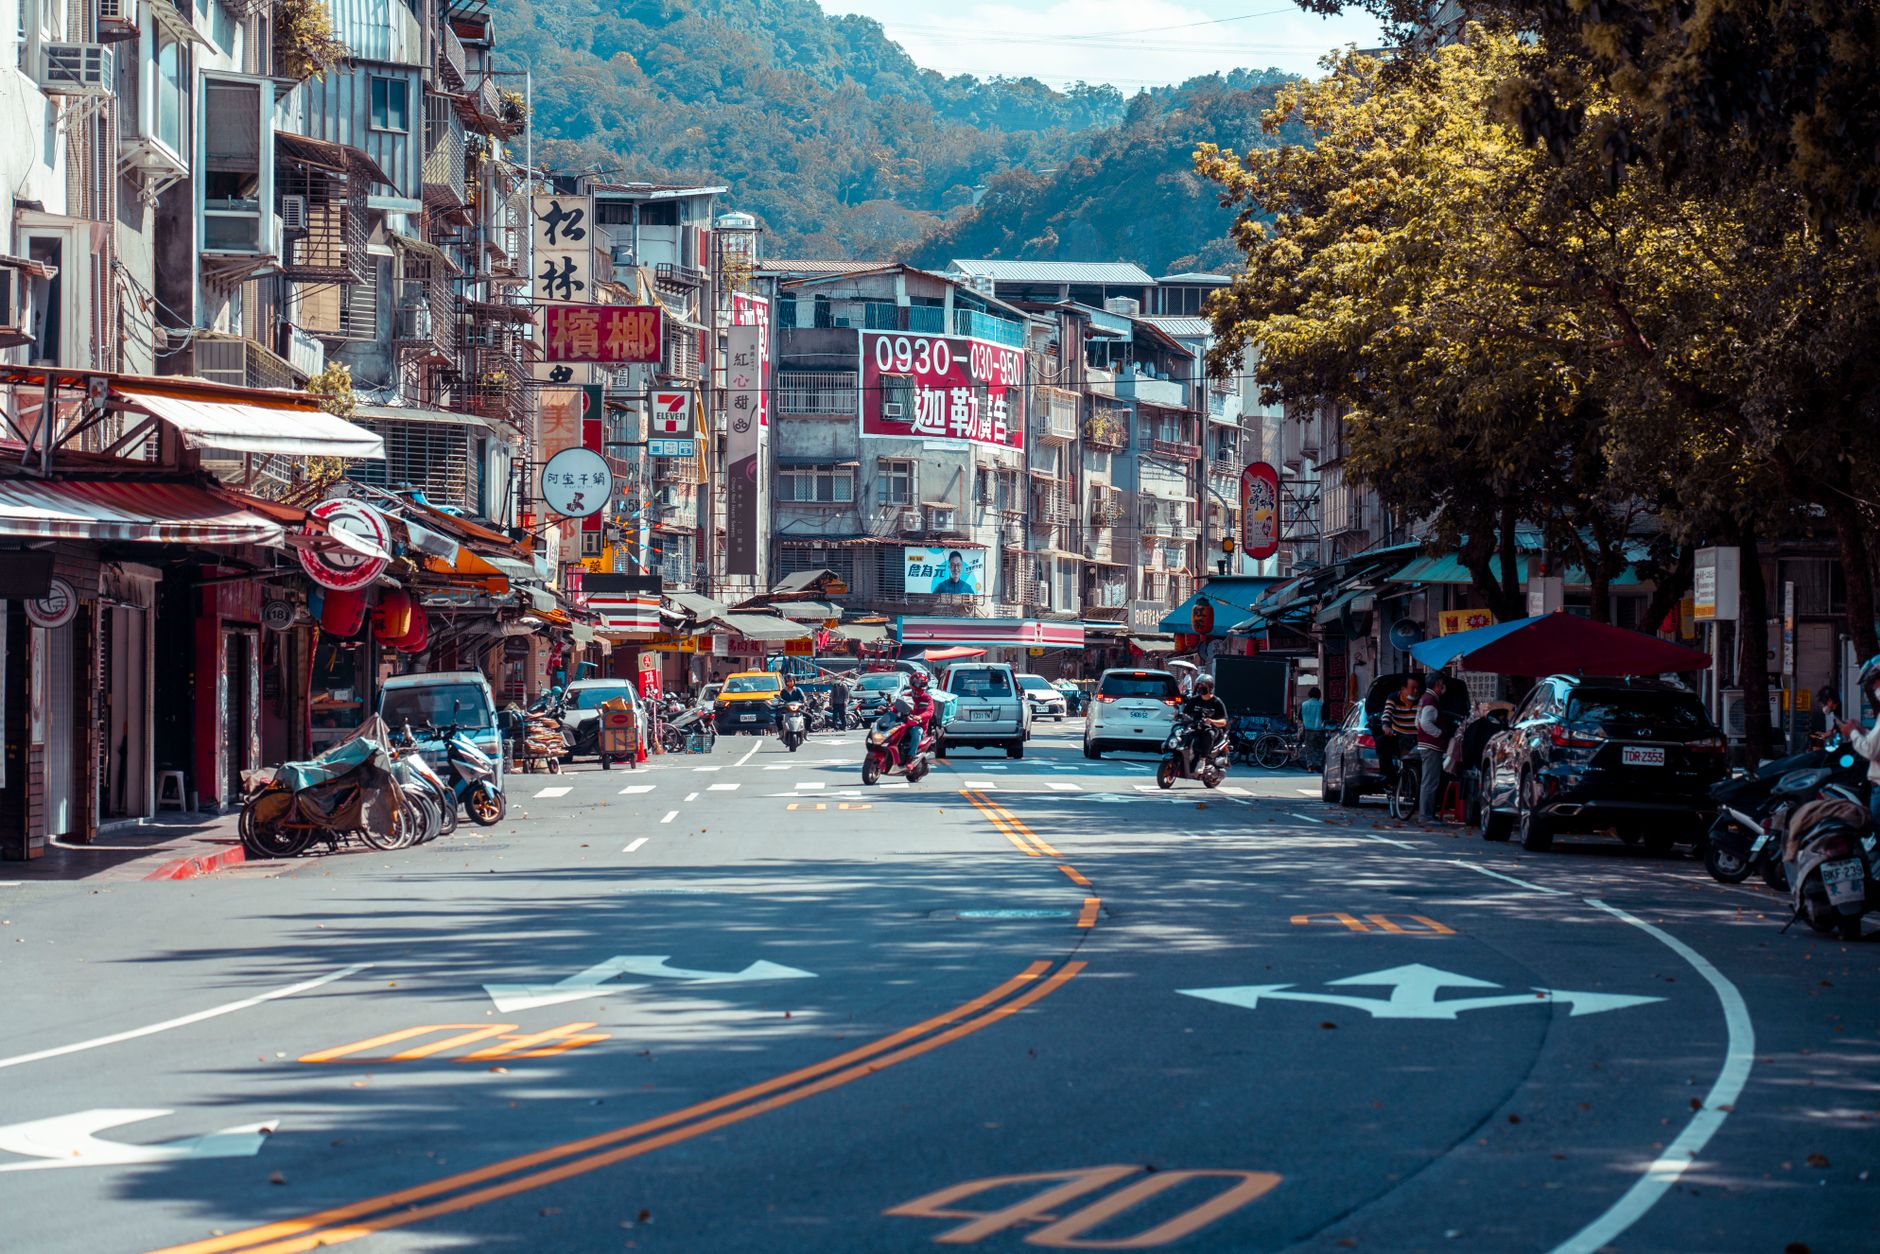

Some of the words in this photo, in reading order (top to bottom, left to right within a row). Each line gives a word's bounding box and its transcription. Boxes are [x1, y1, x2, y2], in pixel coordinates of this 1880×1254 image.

[551, 308, 656, 360] 檳榔
[875, 335, 1021, 386] 0930-030-950
[907, 563, 947, 578] 詹為元
[880, 1163, 1283, 1248] 40
